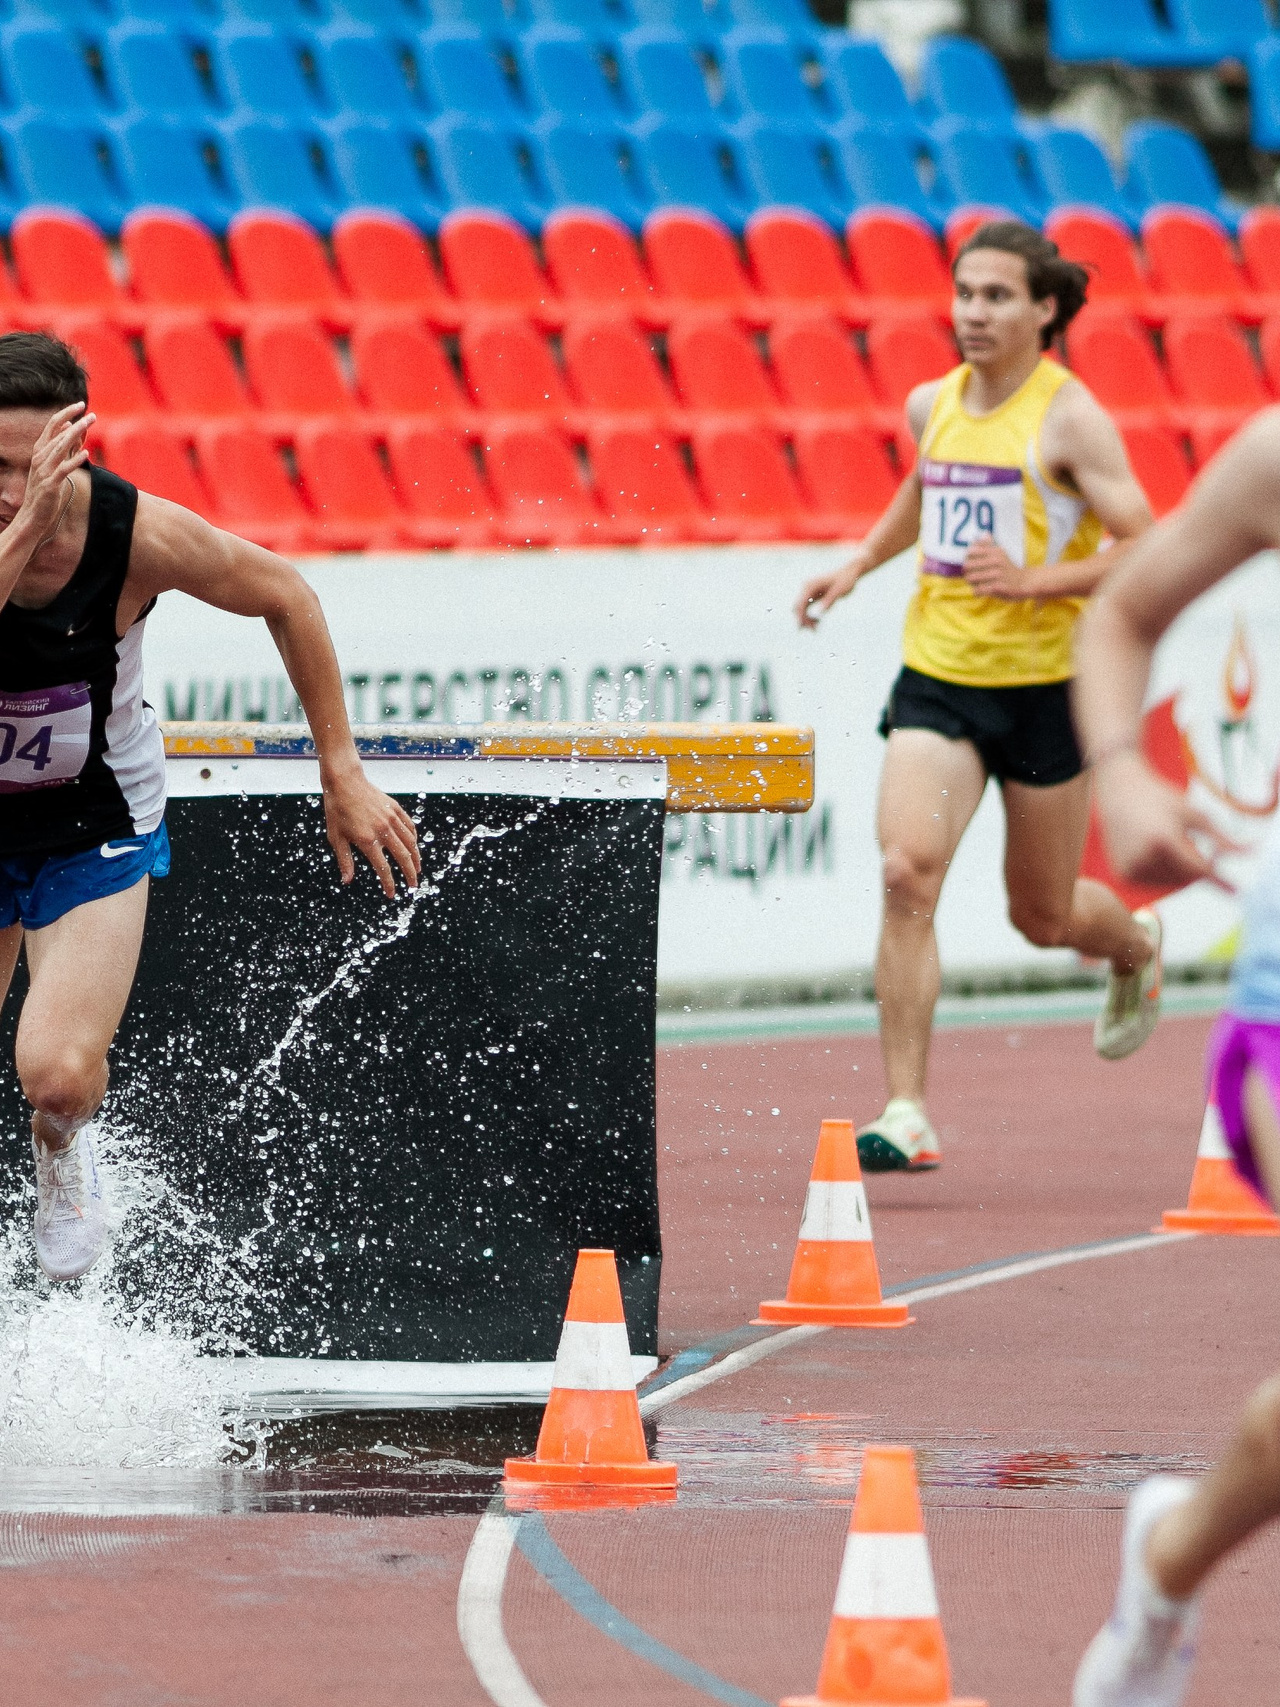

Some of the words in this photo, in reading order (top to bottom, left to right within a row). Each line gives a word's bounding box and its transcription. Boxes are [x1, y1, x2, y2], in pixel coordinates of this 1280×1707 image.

[939, 497, 995, 547] 129
[3, 702, 49, 712] ЛИЗИНГ
[164, 665, 569, 722] МИНИТЕРСТВО
[585, 661, 777, 722] СПОРТА
[662, 801, 834, 893] РАЦИИ
